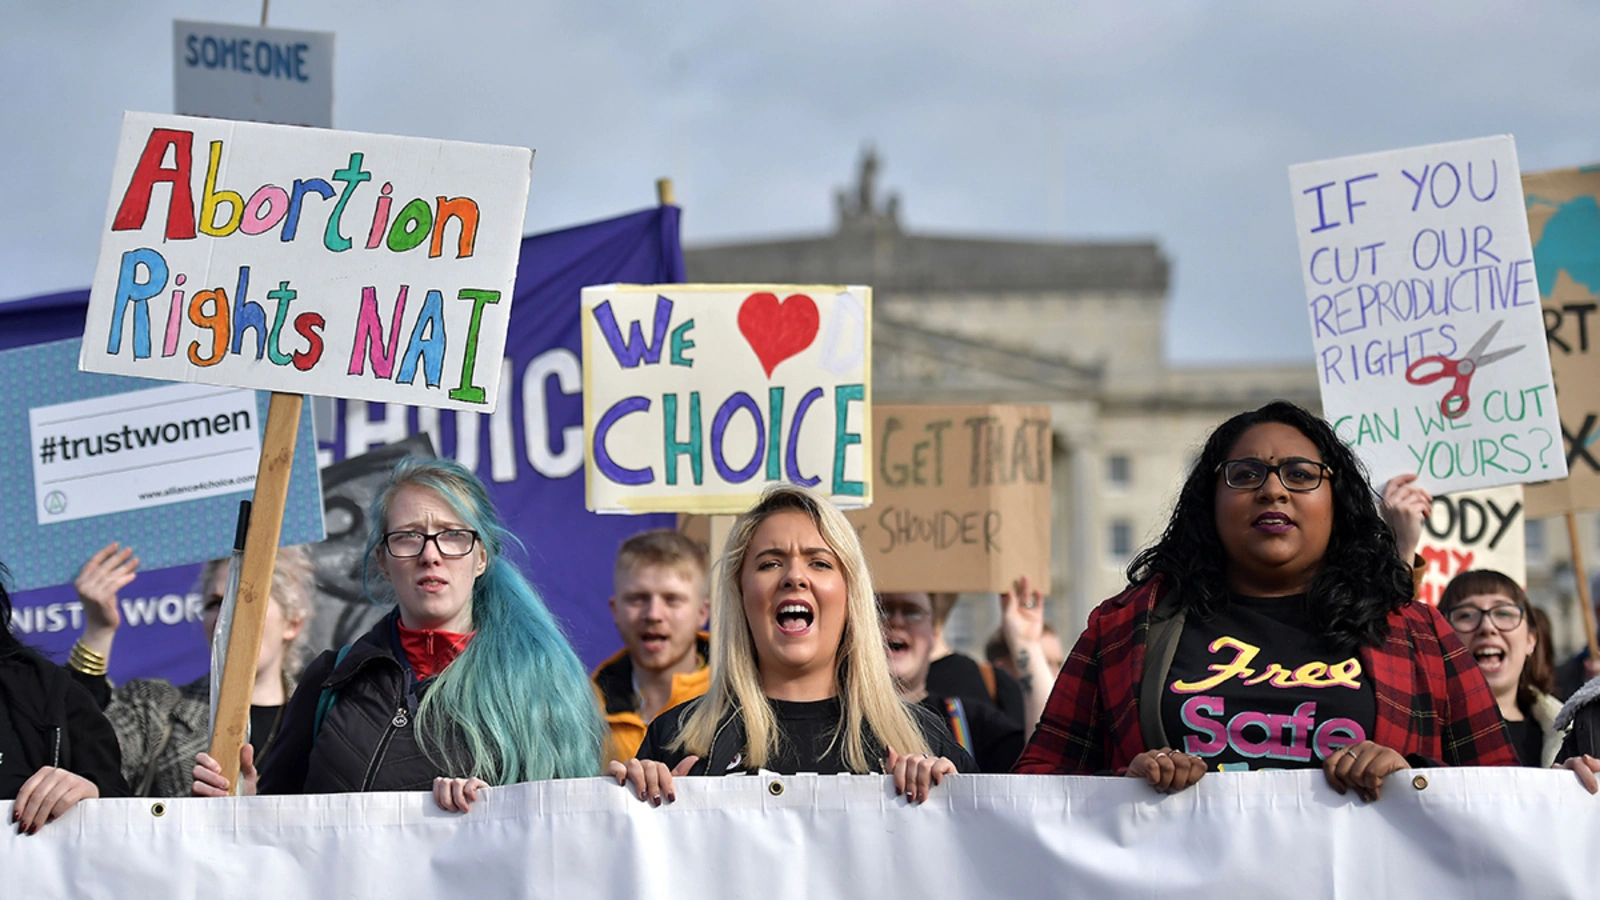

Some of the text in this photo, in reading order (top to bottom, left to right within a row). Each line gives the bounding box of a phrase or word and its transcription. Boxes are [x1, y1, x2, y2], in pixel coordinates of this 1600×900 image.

[185, 34, 309, 83] SOMEONE
[112, 127, 480, 259] Abortion
[1303, 159, 1498, 233] IF YOU
[1310, 225, 1501, 285] CUT OUR
[106, 248, 501, 404] Rights NAI
[1310, 259, 1535, 338] REPRODUCTIVE
[1543, 303, 1597, 354] RT
[592, 295, 695, 368] WE
[1321, 323, 1458, 384] RIGHTS
[40, 409, 251, 464] #trustwomen
[593, 383, 865, 496] CHOICE
[1334, 384, 1549, 447] CAN WE CUT
[880, 416, 1050, 488] GET THAT
[1407, 427, 1553, 479] YOURS?
[1424, 494, 1522, 550] ODY
[11, 593, 204, 634] NIST WOR
[1171, 636, 1362, 694] Free
[1180, 695, 1367, 762] Safe
